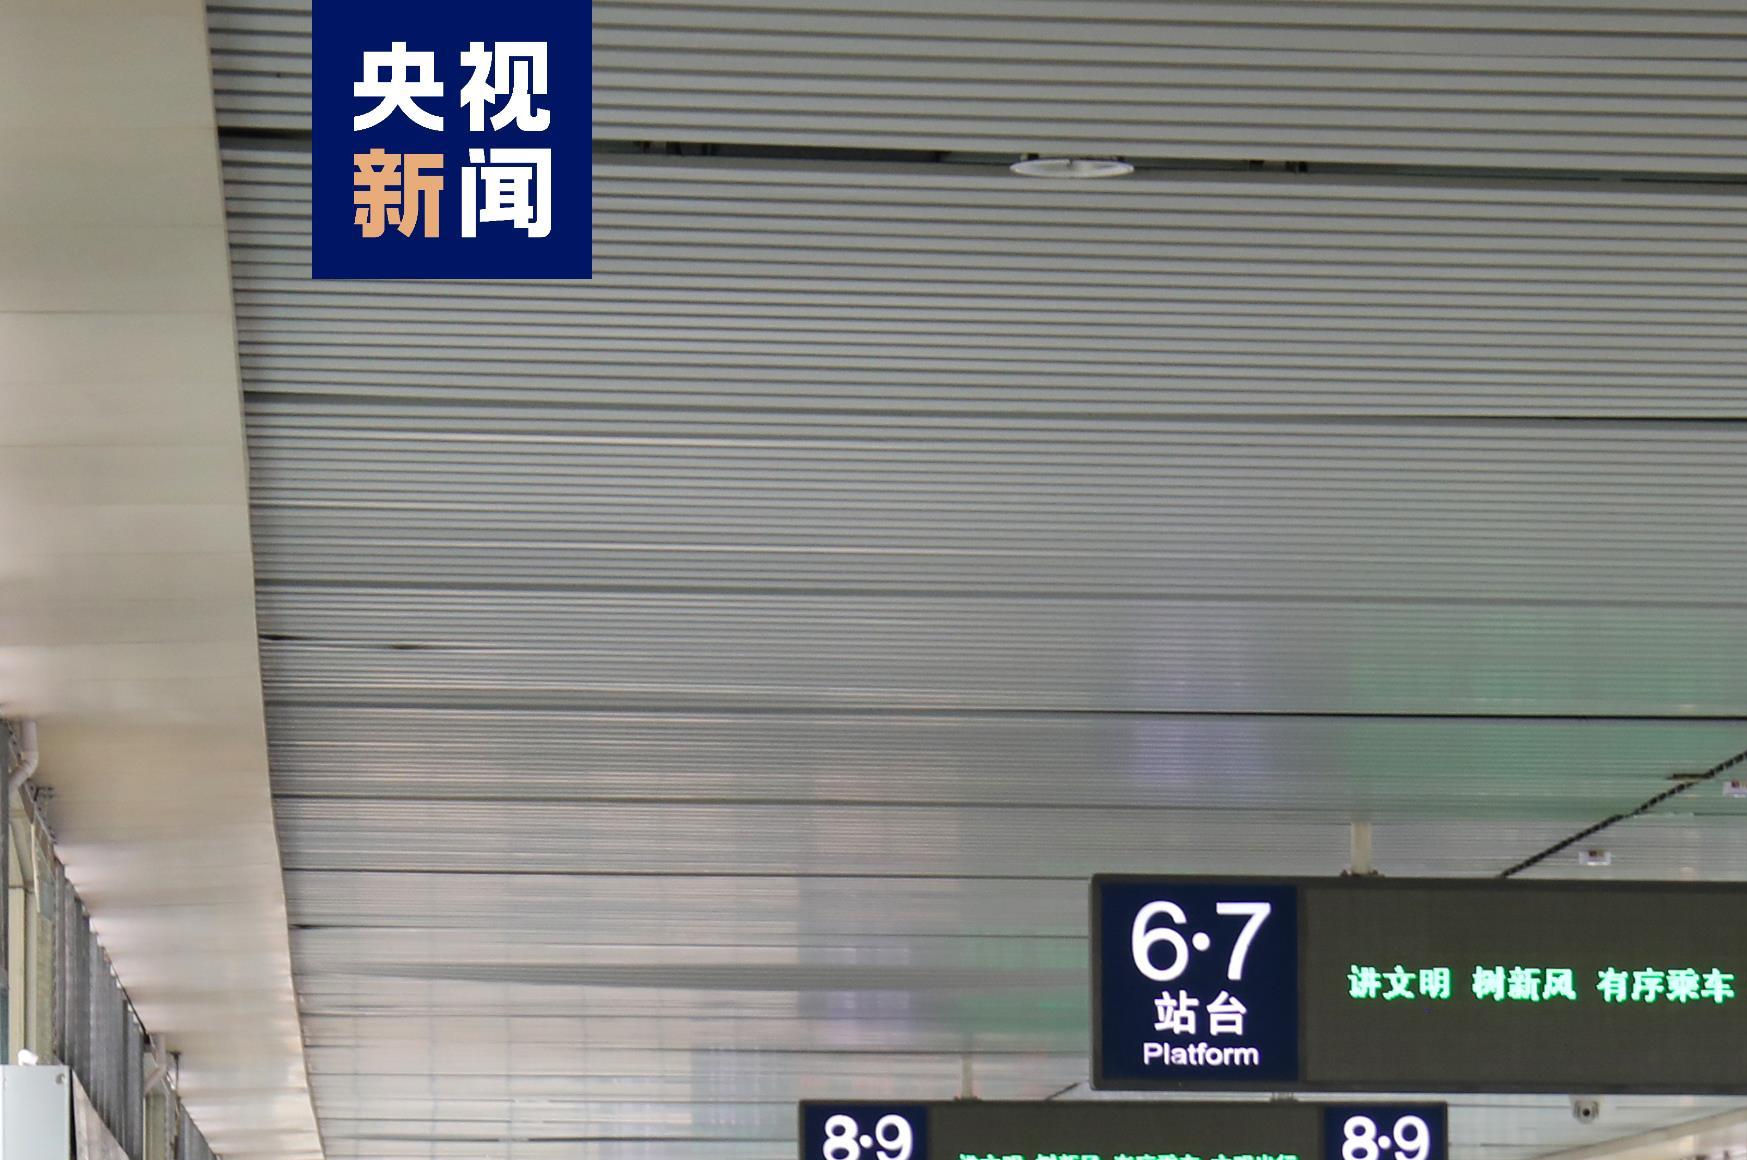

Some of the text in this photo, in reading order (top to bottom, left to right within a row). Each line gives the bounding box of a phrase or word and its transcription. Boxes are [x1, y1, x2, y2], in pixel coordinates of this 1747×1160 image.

[1347, 965, 1451, 1001] 讲文明
[1472, 966, 1577, 1002] 树新风
[1597, 967, 1735, 1004] 有序乘车
[1155, 990, 1247, 1036] 站台
[1143, 1043, 1259, 1066] Platform
